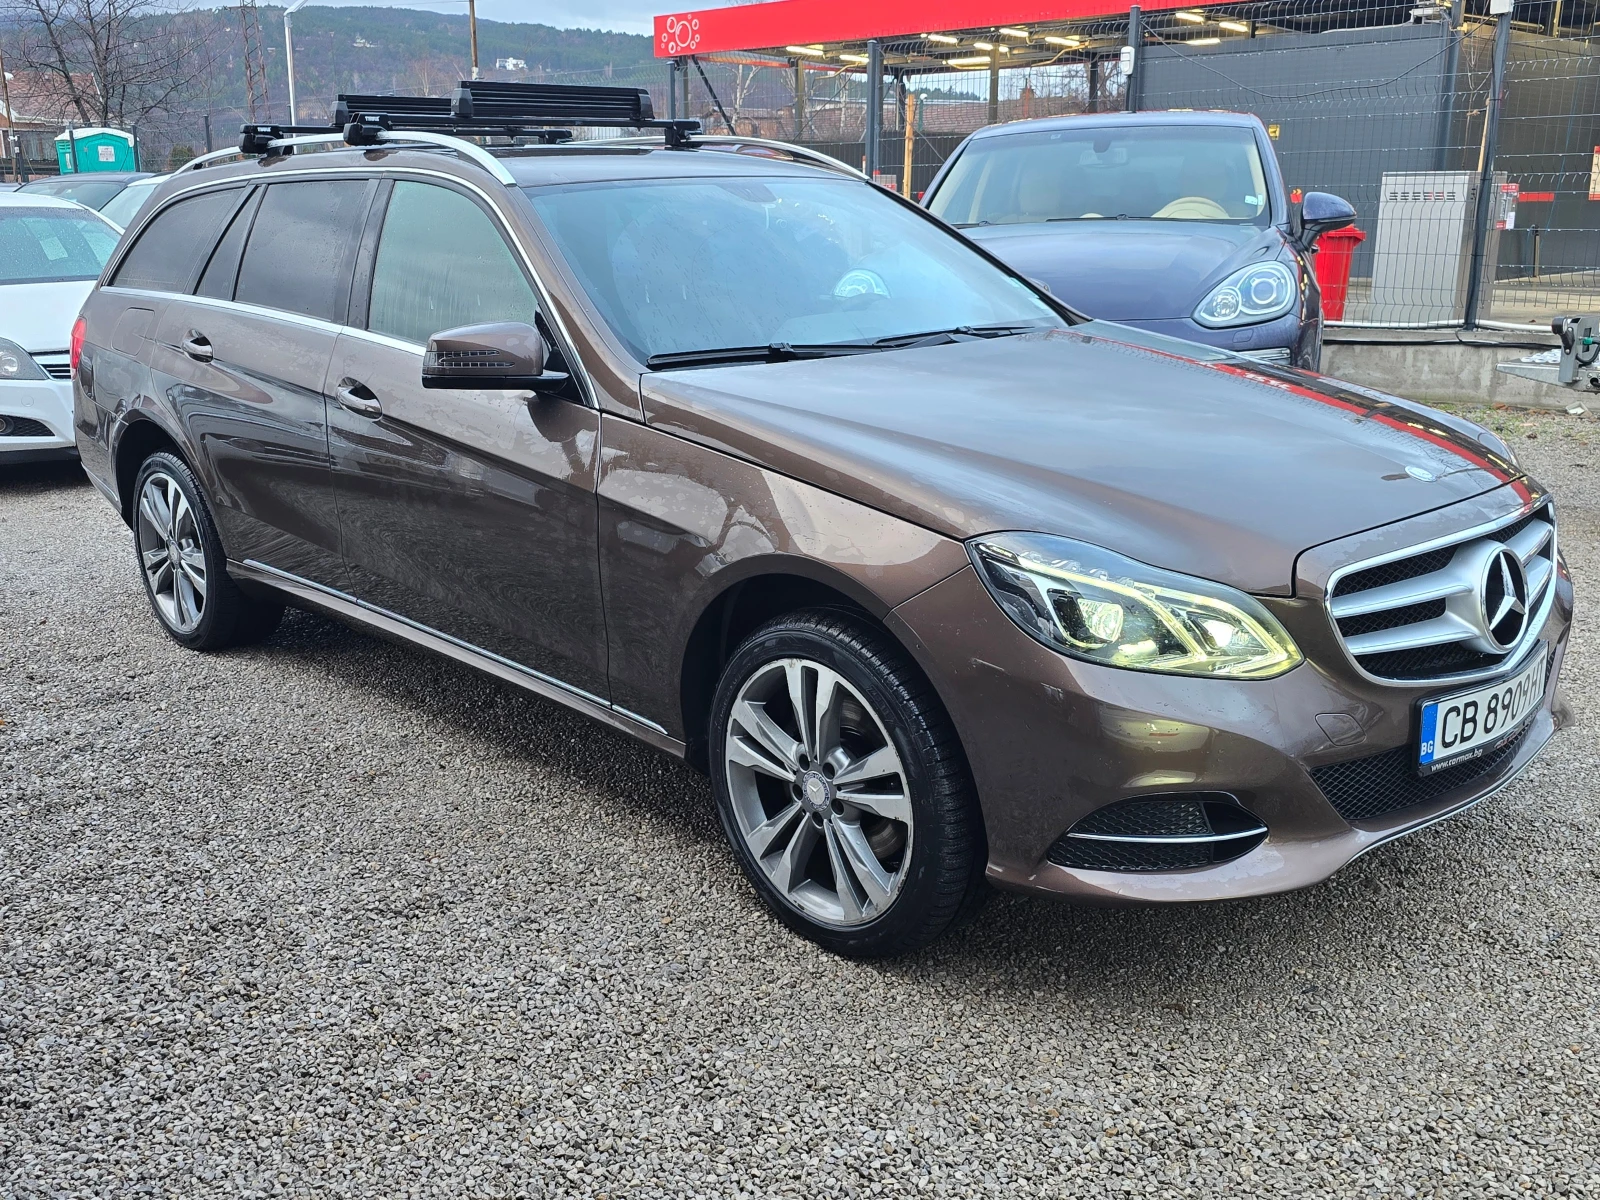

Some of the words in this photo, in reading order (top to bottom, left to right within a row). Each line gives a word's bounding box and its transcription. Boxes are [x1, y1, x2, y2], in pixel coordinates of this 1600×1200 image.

[1441, 700, 1478, 749] CB
[1420, 740, 1434, 756] BG
[1431, 748, 1483, 772] www.carmax.bg
